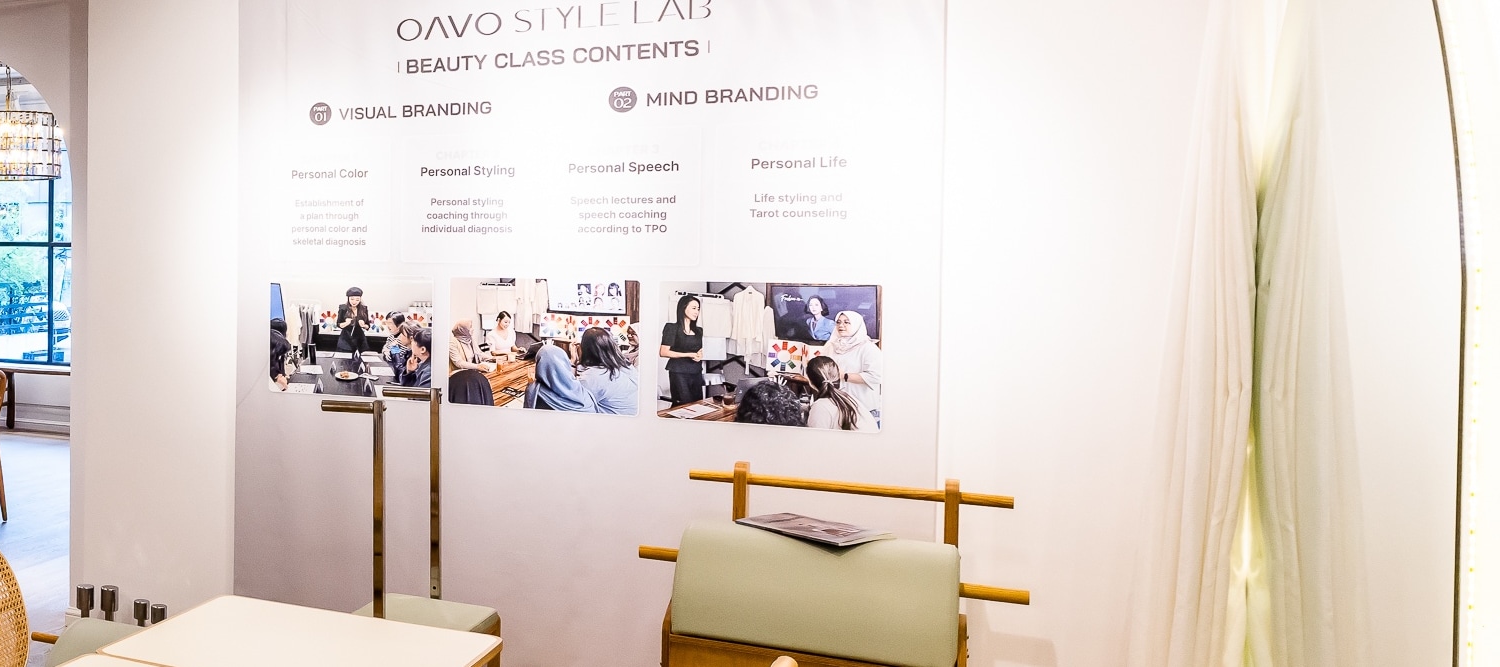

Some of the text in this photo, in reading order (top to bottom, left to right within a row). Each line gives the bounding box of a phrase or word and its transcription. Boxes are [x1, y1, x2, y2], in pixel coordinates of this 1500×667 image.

[515, 2, 619, 32] STYLE
[634, 0, 711, 23] LAB
[407, 40, 699, 74] BEAUTY CLASS CONTENTS
[647, 85, 818, 106] MIND BRANDING
[613, 98, 632, 109] 02
[314, 112, 327, 122] 01
[339, 101, 491, 120] VISUAL BRANDING
[568, 160, 680, 175] Personal Speech
[751, 155, 848, 170] Personal Life
[291, 168, 369, 180] Personal Color
[420, 164, 515, 179] Personal Styling
[430, 197, 504, 208] Personal styling
[570, 194, 677, 207] Speech lectures and
[754, 192, 845, 205] Life styling and
[426, 210, 508, 222] coaching through
[578, 209, 668, 222] speech coaching
[749, 208, 848, 220] Tarot counseling
[291, 224, 368, 235] personal color and
[421, 224, 513, 236] individual diagnosis
[577, 223, 668, 236] according to TPO
[292, 237, 367, 248] skeletal diagnosis
